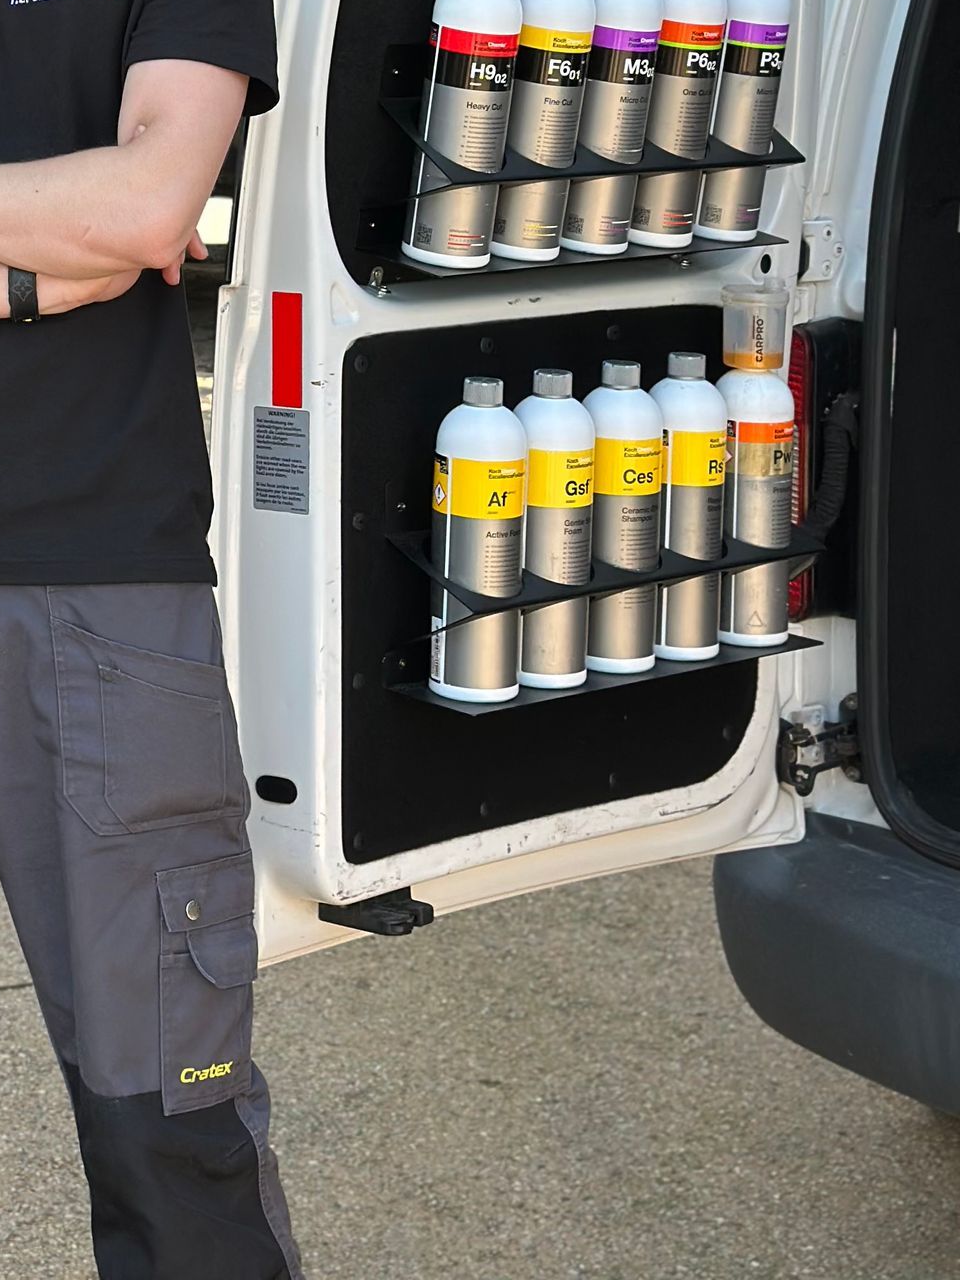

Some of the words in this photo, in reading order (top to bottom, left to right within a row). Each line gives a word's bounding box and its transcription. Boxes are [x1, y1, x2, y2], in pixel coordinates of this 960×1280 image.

[466, 101, 490, 112] Heavy
[491, 103, 503, 111] Cut
[544, 97, 560, 106] Fine
[756, 318, 765, 363] CARPRO
[708, 460, 724, 475] Rs
[623, 468, 654, 485] Ces
[565, 479, 590, 496] Gsf
[487, 491, 508, 507] Af
[180, 1060, 234, 1084] Cratex
